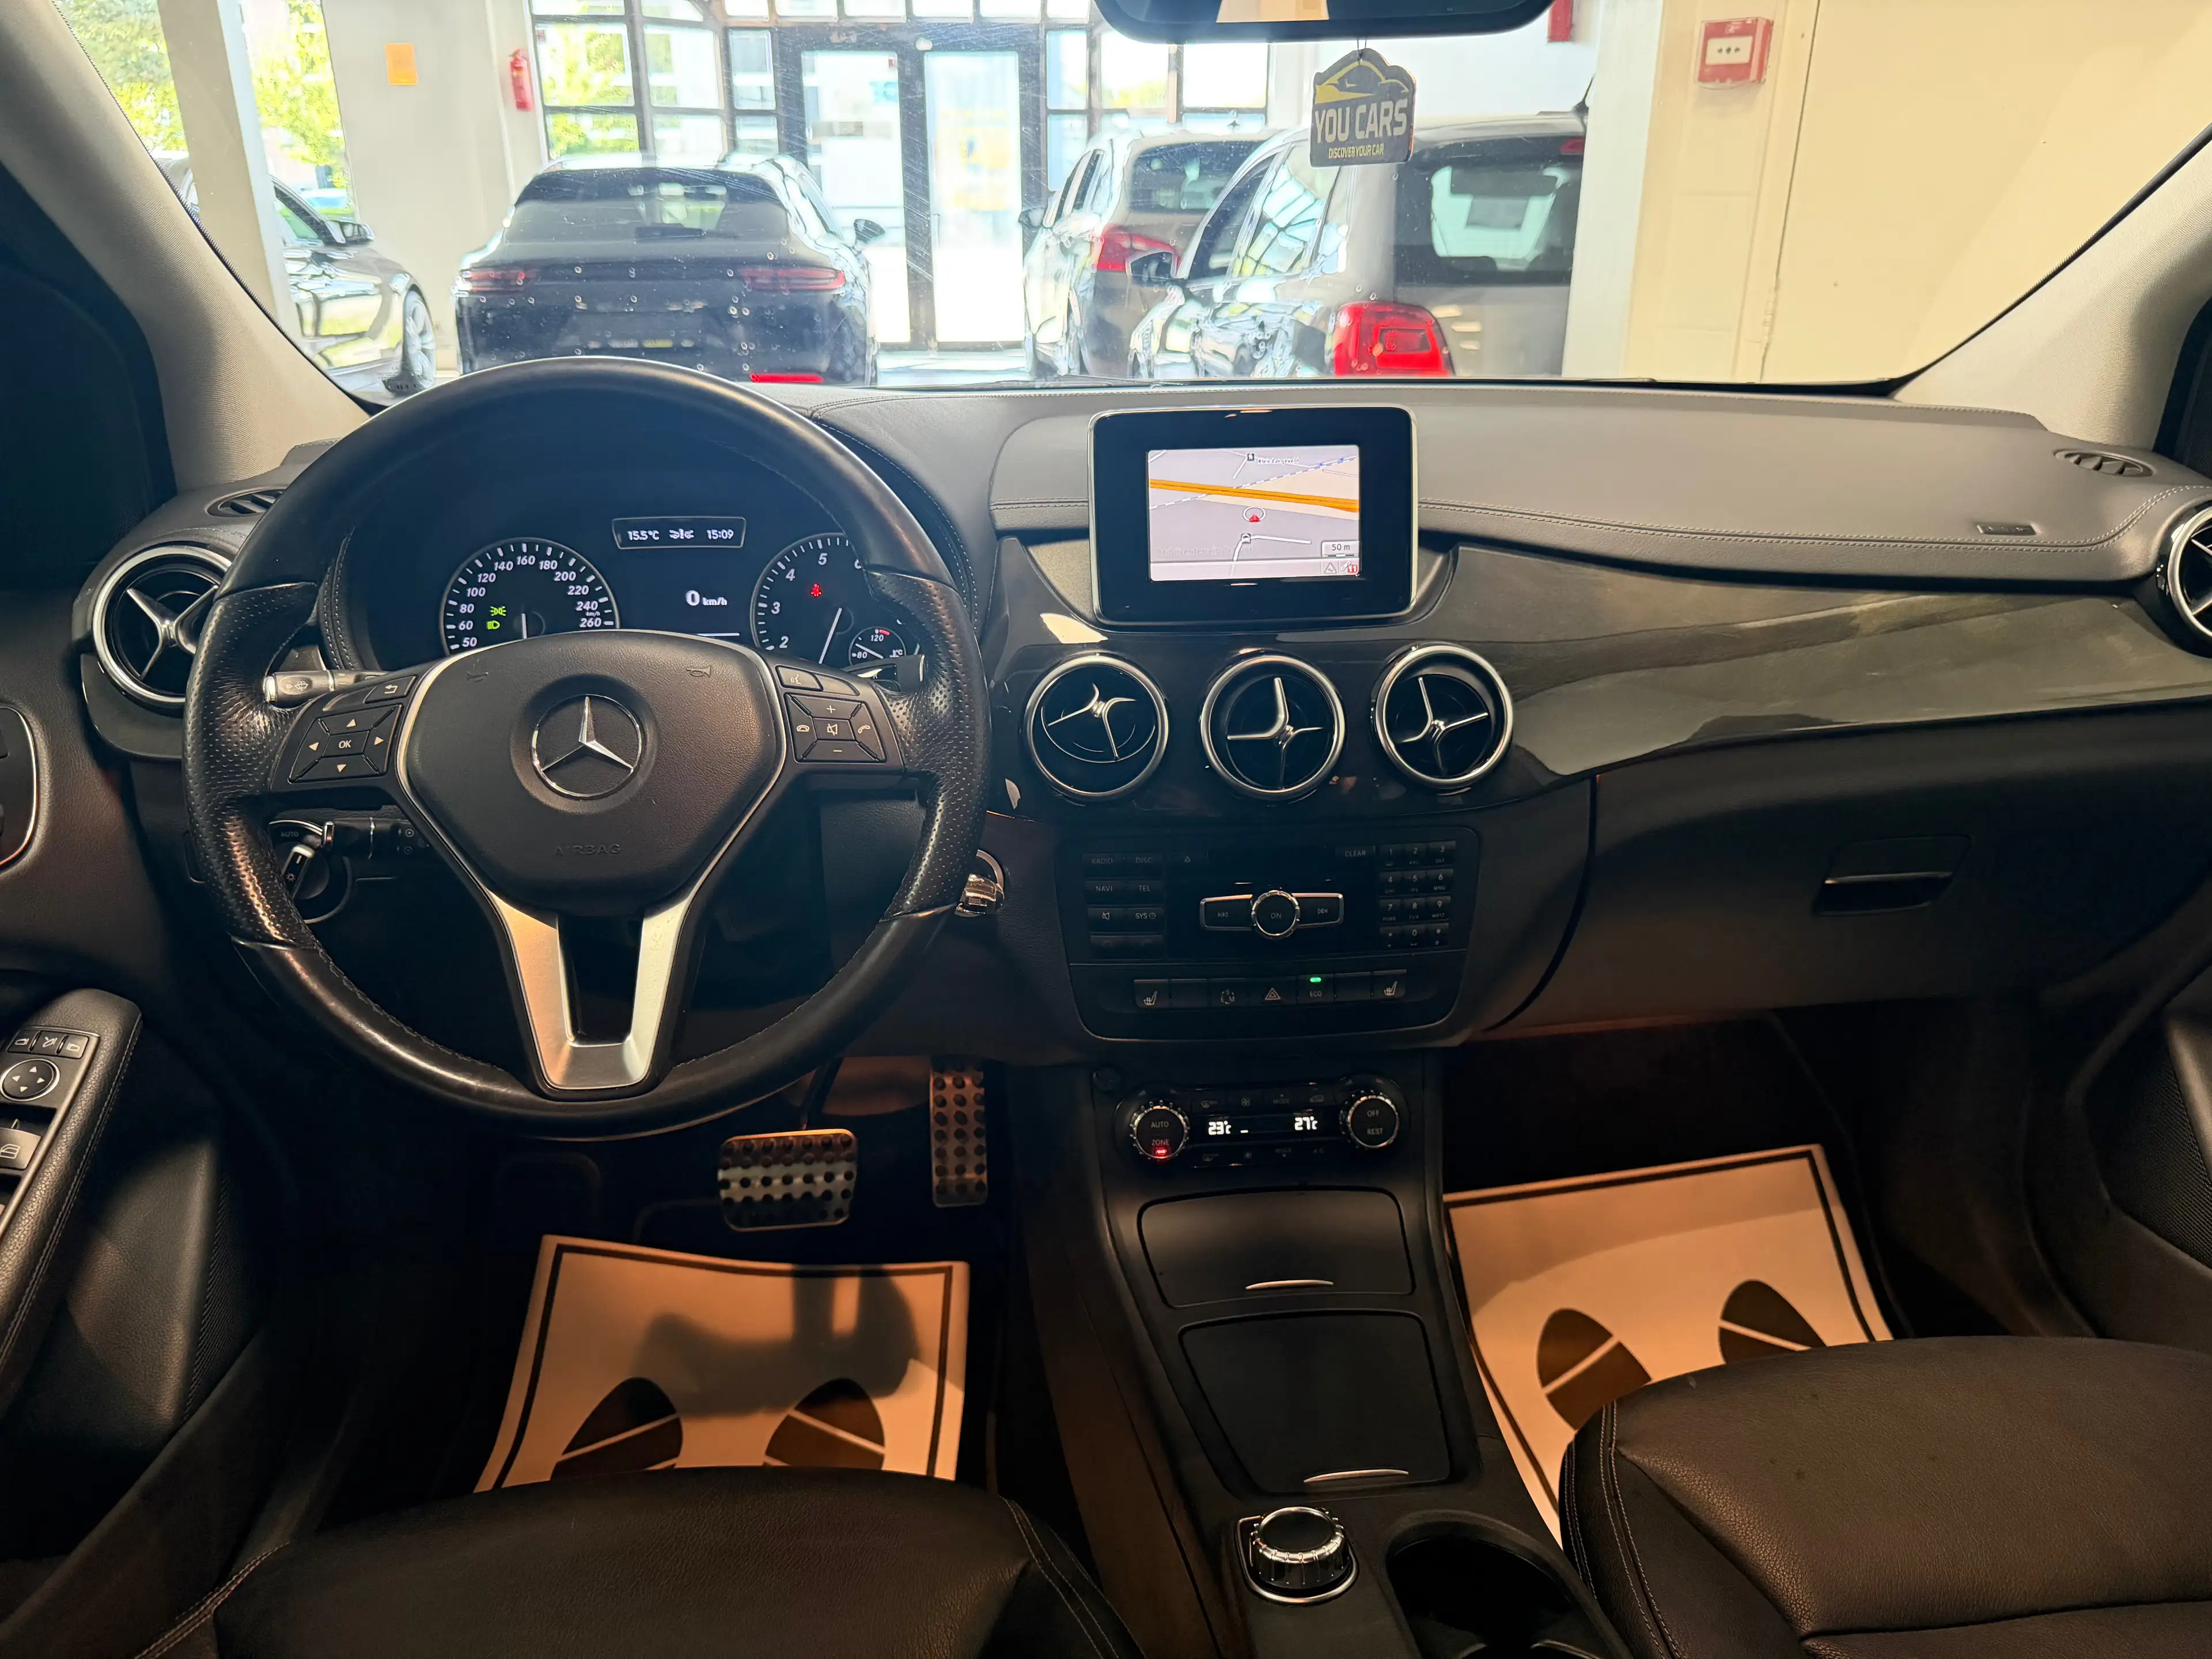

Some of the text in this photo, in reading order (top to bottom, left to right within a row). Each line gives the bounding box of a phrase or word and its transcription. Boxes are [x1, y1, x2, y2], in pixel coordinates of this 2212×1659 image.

[1315, 99, 1408, 143] YOU CARS
[1328, 143, 1384, 159] DISCOVER YOUR CAR
[706, 529, 734, 540] 15:09
[517, 555, 536, 565] 160
[818, 552, 828, 565] 5
[494, 561, 514, 571] 140
[539, 560, 558, 570] 180
[478, 573, 496, 583] 120
[554, 571, 576, 581] 200
[785, 569, 796, 581] 4
[467, 588, 486, 597] 100
[567, 585, 589, 595] 220
[685, 590, 728, 606] 0 km/h
[459, 604, 475, 613] 80
[575, 601, 599, 611] 240
[771, 602, 781, 615] 3
[459, 620, 474, 630] 60
[579, 618, 602, 627] 260
[462, 637, 478, 647] 50
[779, 636, 789, 649] 2
[339, 740, 351, 749] OK
[1412, 929, 1417, 937] 0
[1367, 1109, 1380, 1118] OFF
[1150, 1120, 1169, 1128] AUTO
[1367, 1127, 1383, 1135] REST
[1151, 1138, 1170, 1146] ZONE
